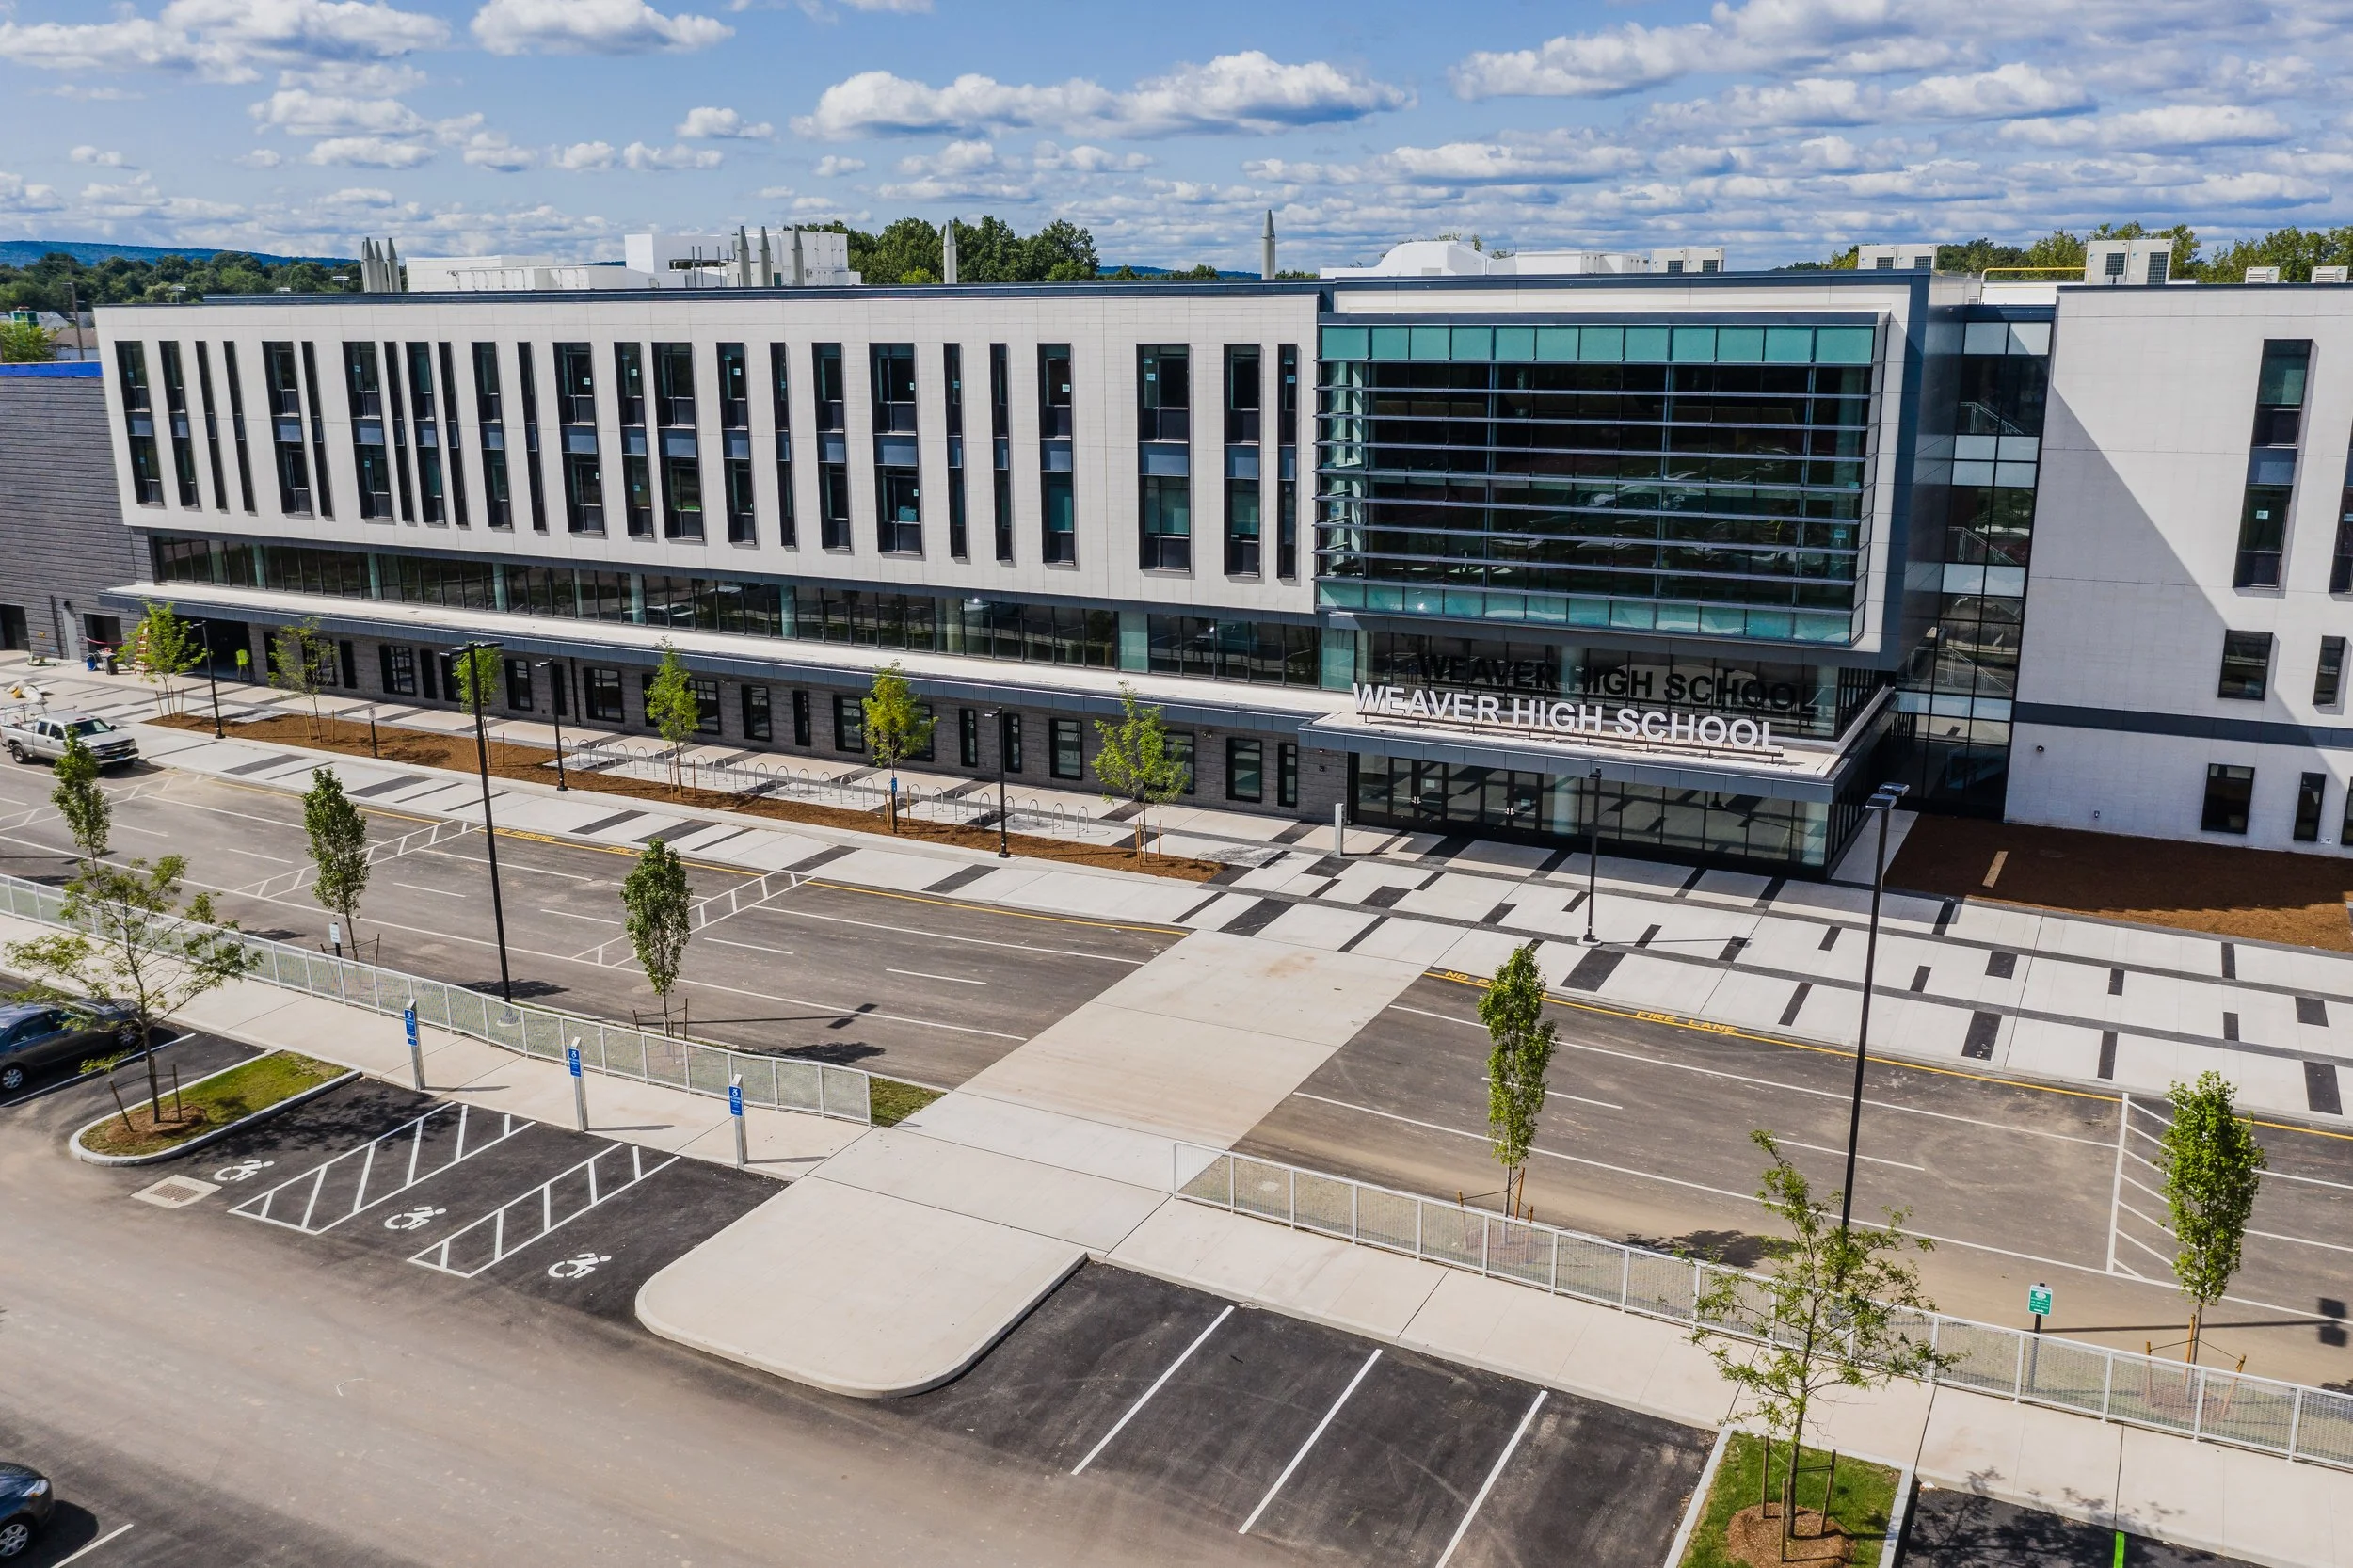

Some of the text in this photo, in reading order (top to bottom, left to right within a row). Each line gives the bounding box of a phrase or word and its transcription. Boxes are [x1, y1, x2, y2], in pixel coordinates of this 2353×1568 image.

[1352, 682, 1783, 752] WEAVER HIGH SCHOOL
[1445, 970, 1469, 981] NO
[1637, 1010, 1738, 1033] FIRE LANE
